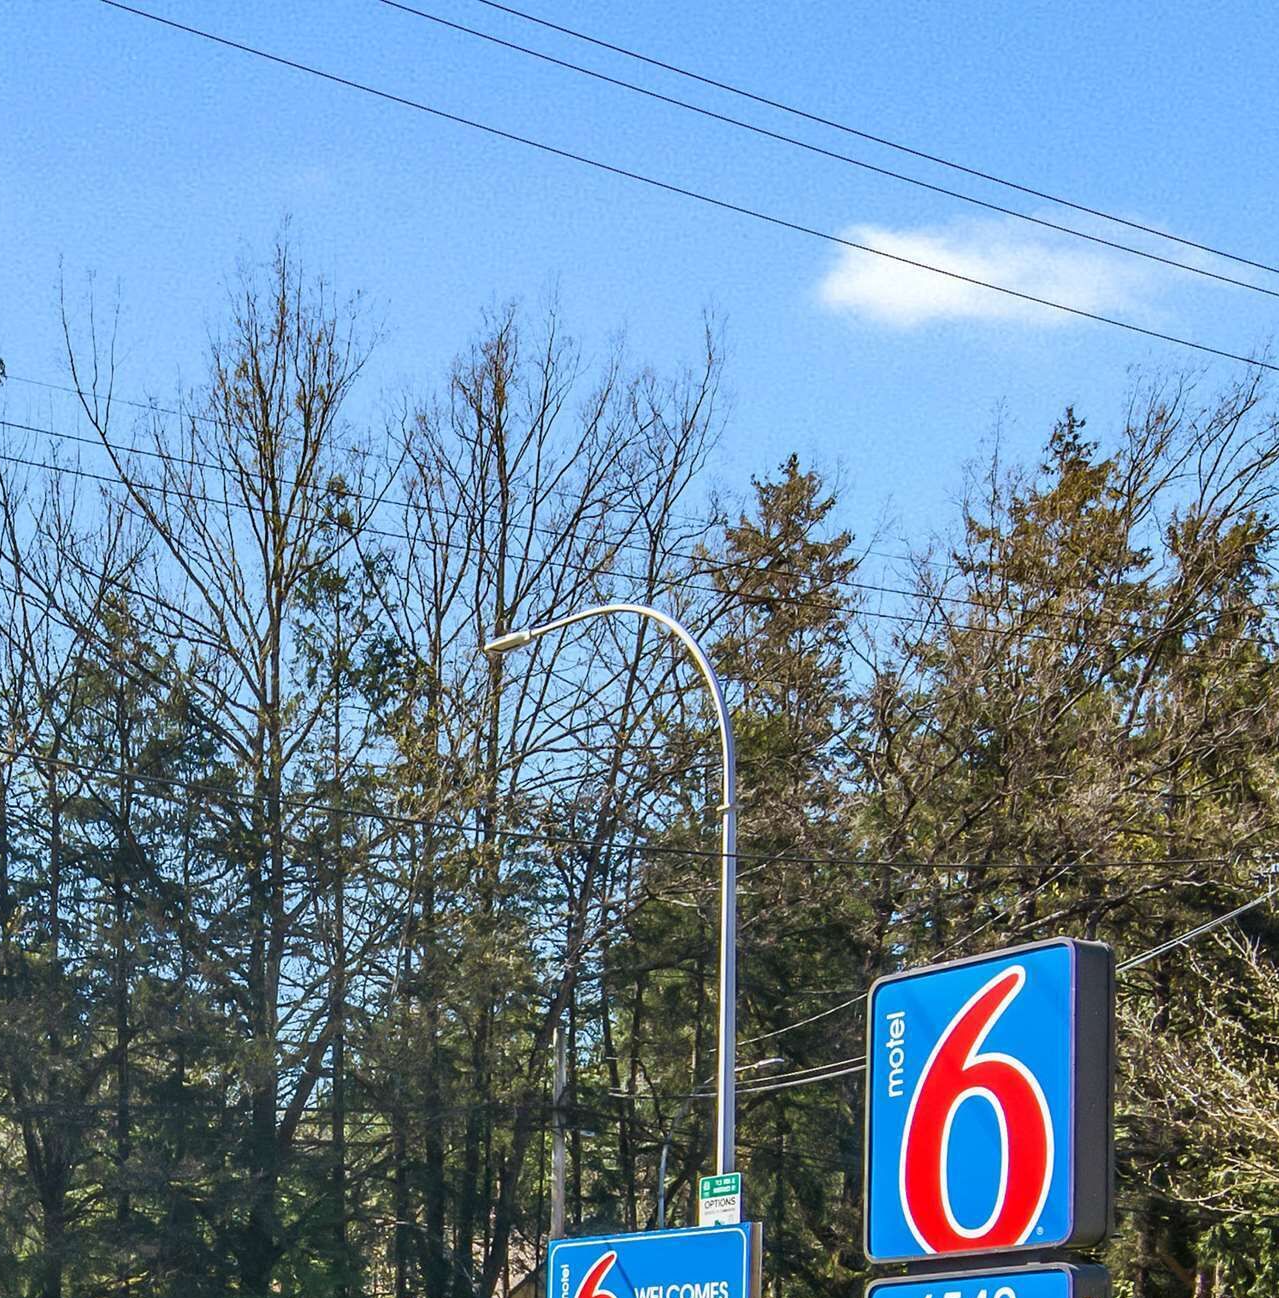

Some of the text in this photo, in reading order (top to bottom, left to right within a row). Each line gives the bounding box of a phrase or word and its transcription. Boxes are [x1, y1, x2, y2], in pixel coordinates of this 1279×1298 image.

[886, 964, 1055, 1255] motel 6
[704, 1196, 736, 1209] OPTIONS
